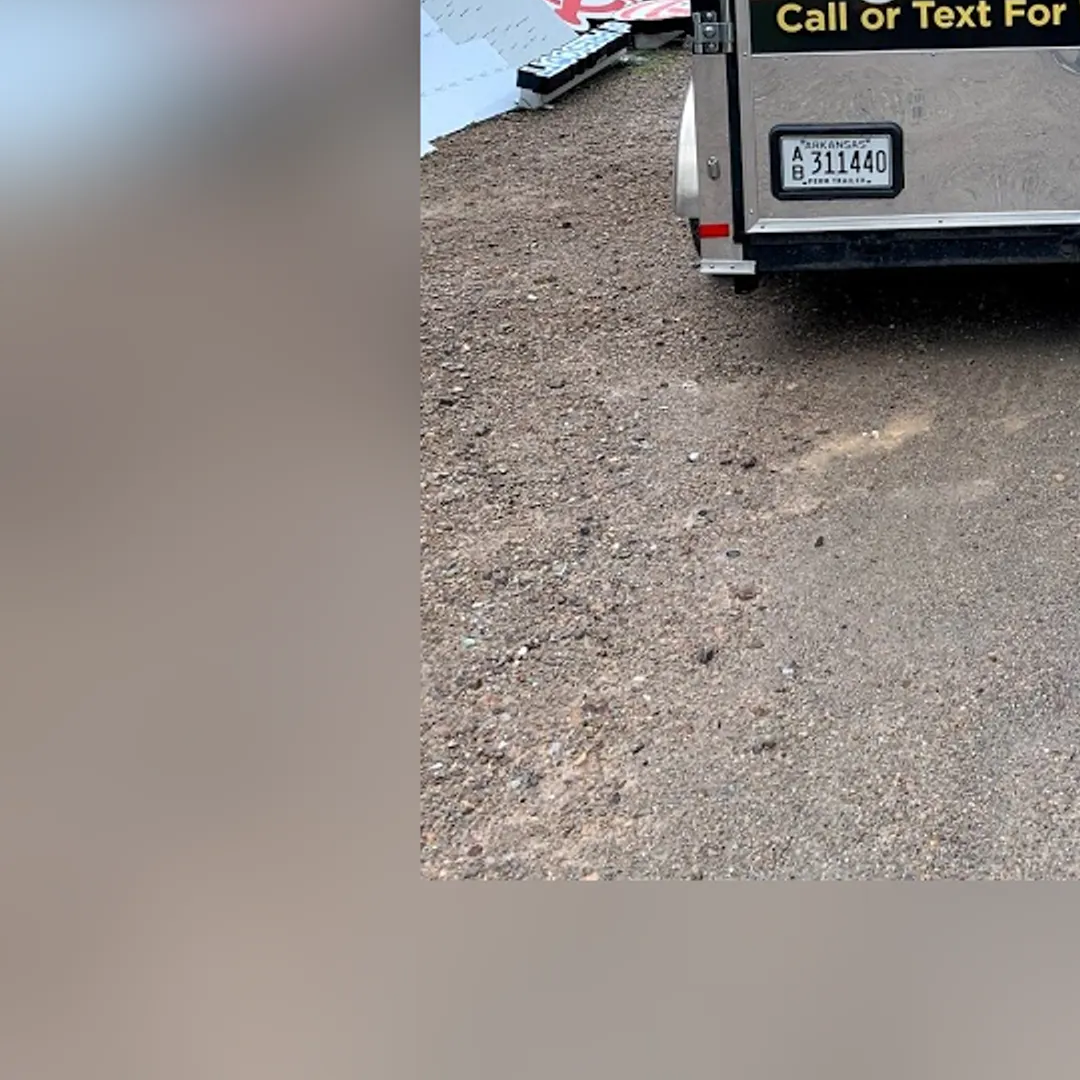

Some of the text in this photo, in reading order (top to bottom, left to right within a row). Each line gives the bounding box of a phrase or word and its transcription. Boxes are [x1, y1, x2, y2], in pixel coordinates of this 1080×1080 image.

[776, 2, 847, 33] Call
[861, 5, 900, 32] or
[912, 0, 991, 29] Text
[811, 150, 886, 174] 311440
